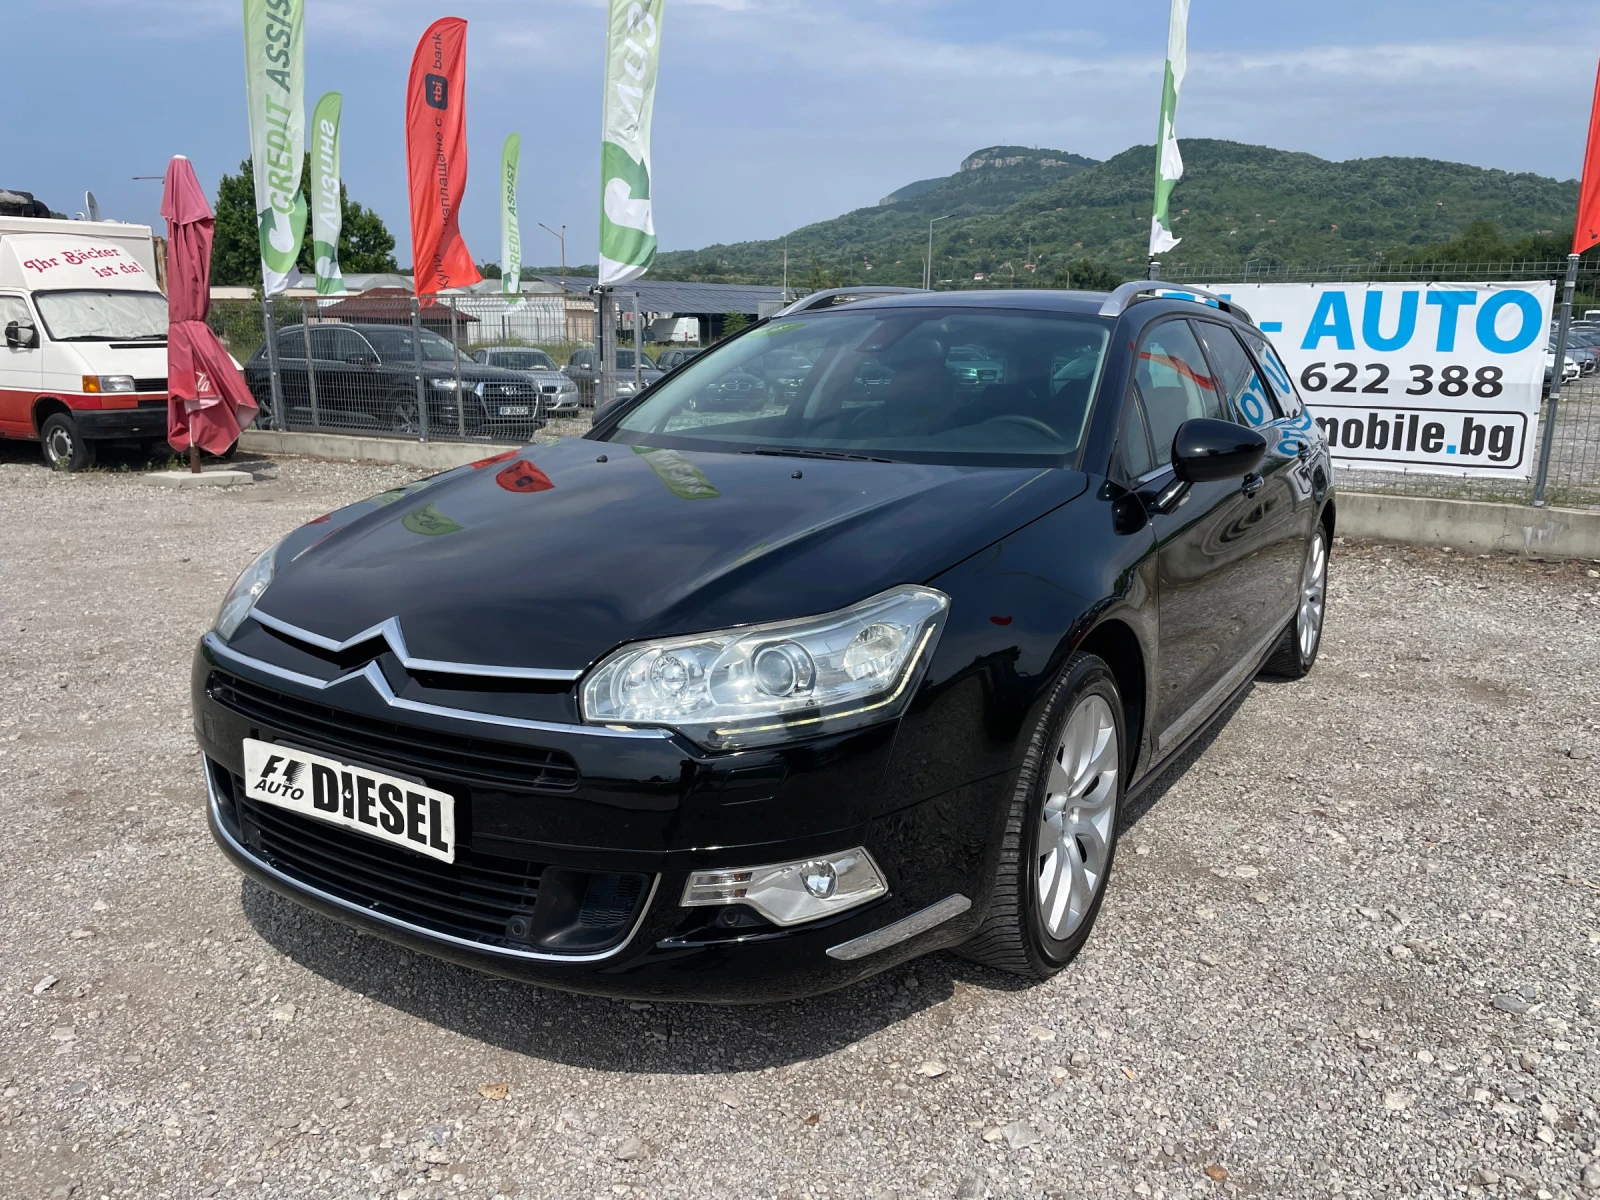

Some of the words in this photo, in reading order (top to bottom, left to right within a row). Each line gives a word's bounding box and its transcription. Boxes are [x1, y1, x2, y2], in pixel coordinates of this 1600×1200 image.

[432, 31, 443, 70] bank
[617, 0, 657, 122] Лиз
[432, 80, 443, 102] tbi
[266, 93, 296, 215] CREDIT
[506, 158, 518, 217] ASSIST
[23, 258, 60, 274] Ihr
[60, 247, 121, 265] Bäcker
[91, 265, 119, 278] ist
[119, 261, 145, 274] da!
[508, 218, 520, 276] CREDIT
[1299, 289, 1543, 355] AUTO
[1300, 361, 1391, 395] 622
[1405, 364, 1505, 399] 388
[1315, 412, 1516, 463] mobile.bg
[254, 778, 305, 801] AUTO
[311, 762, 450, 854] DIESEL
